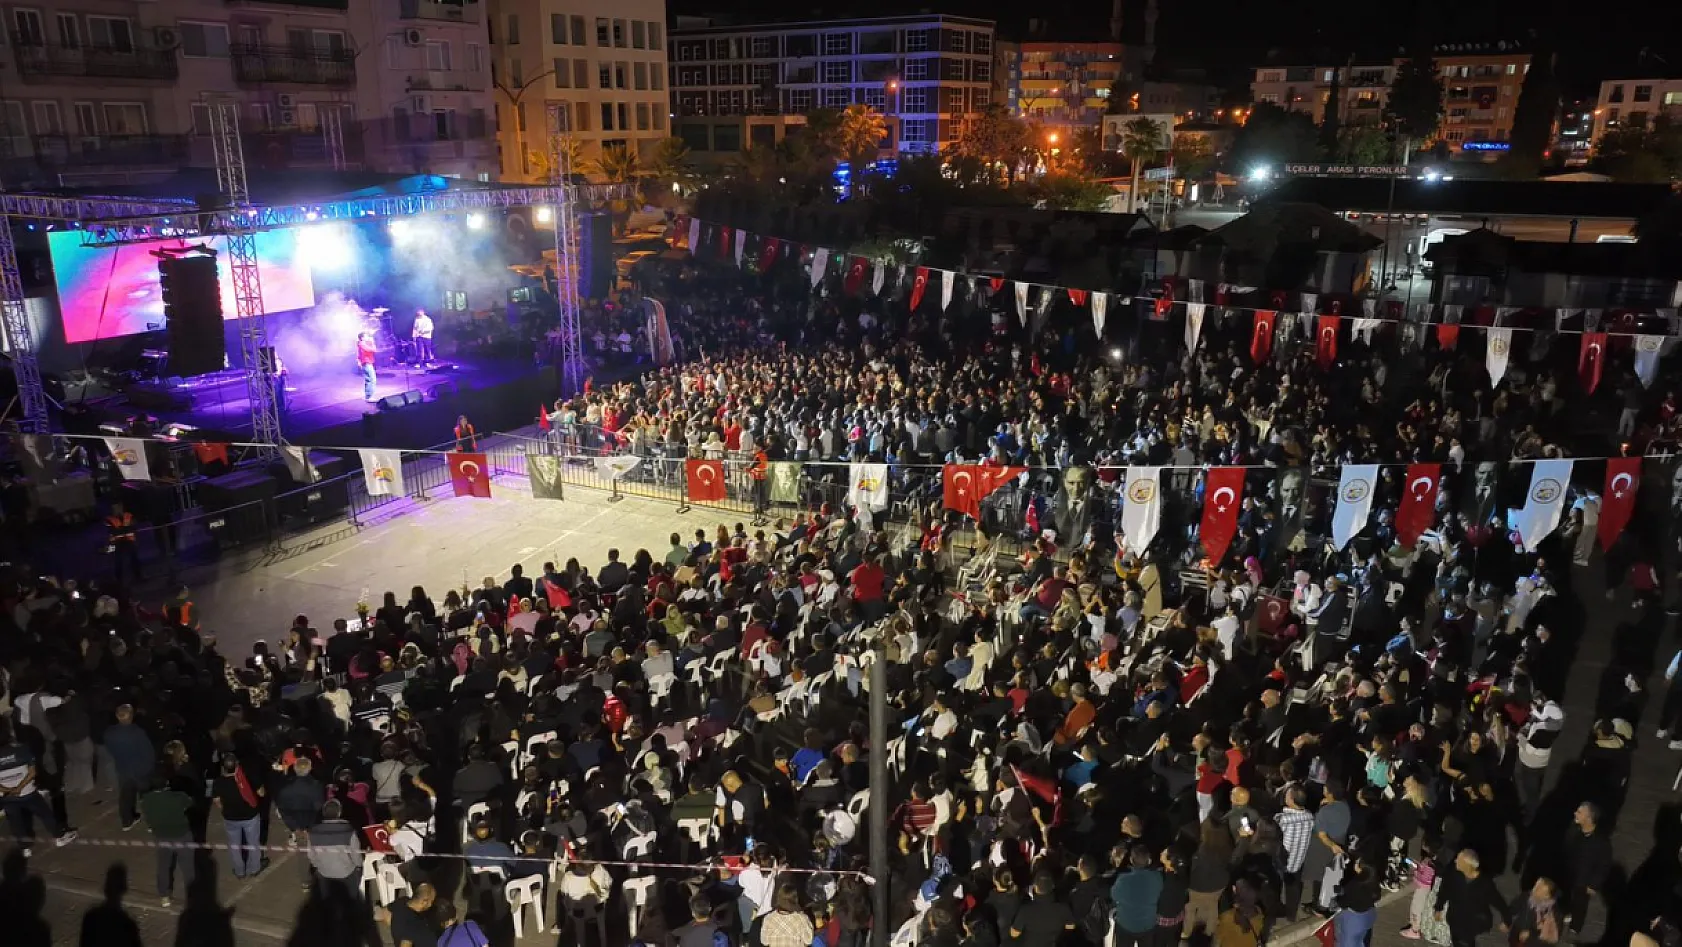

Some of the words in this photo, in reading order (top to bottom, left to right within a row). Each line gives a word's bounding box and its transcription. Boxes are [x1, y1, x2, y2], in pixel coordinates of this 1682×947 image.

[1285, 163, 1320, 174] İLÇELER
[1327, 165, 1354, 174] ARASI
[1358, 166, 1407, 175] PERONLAR
